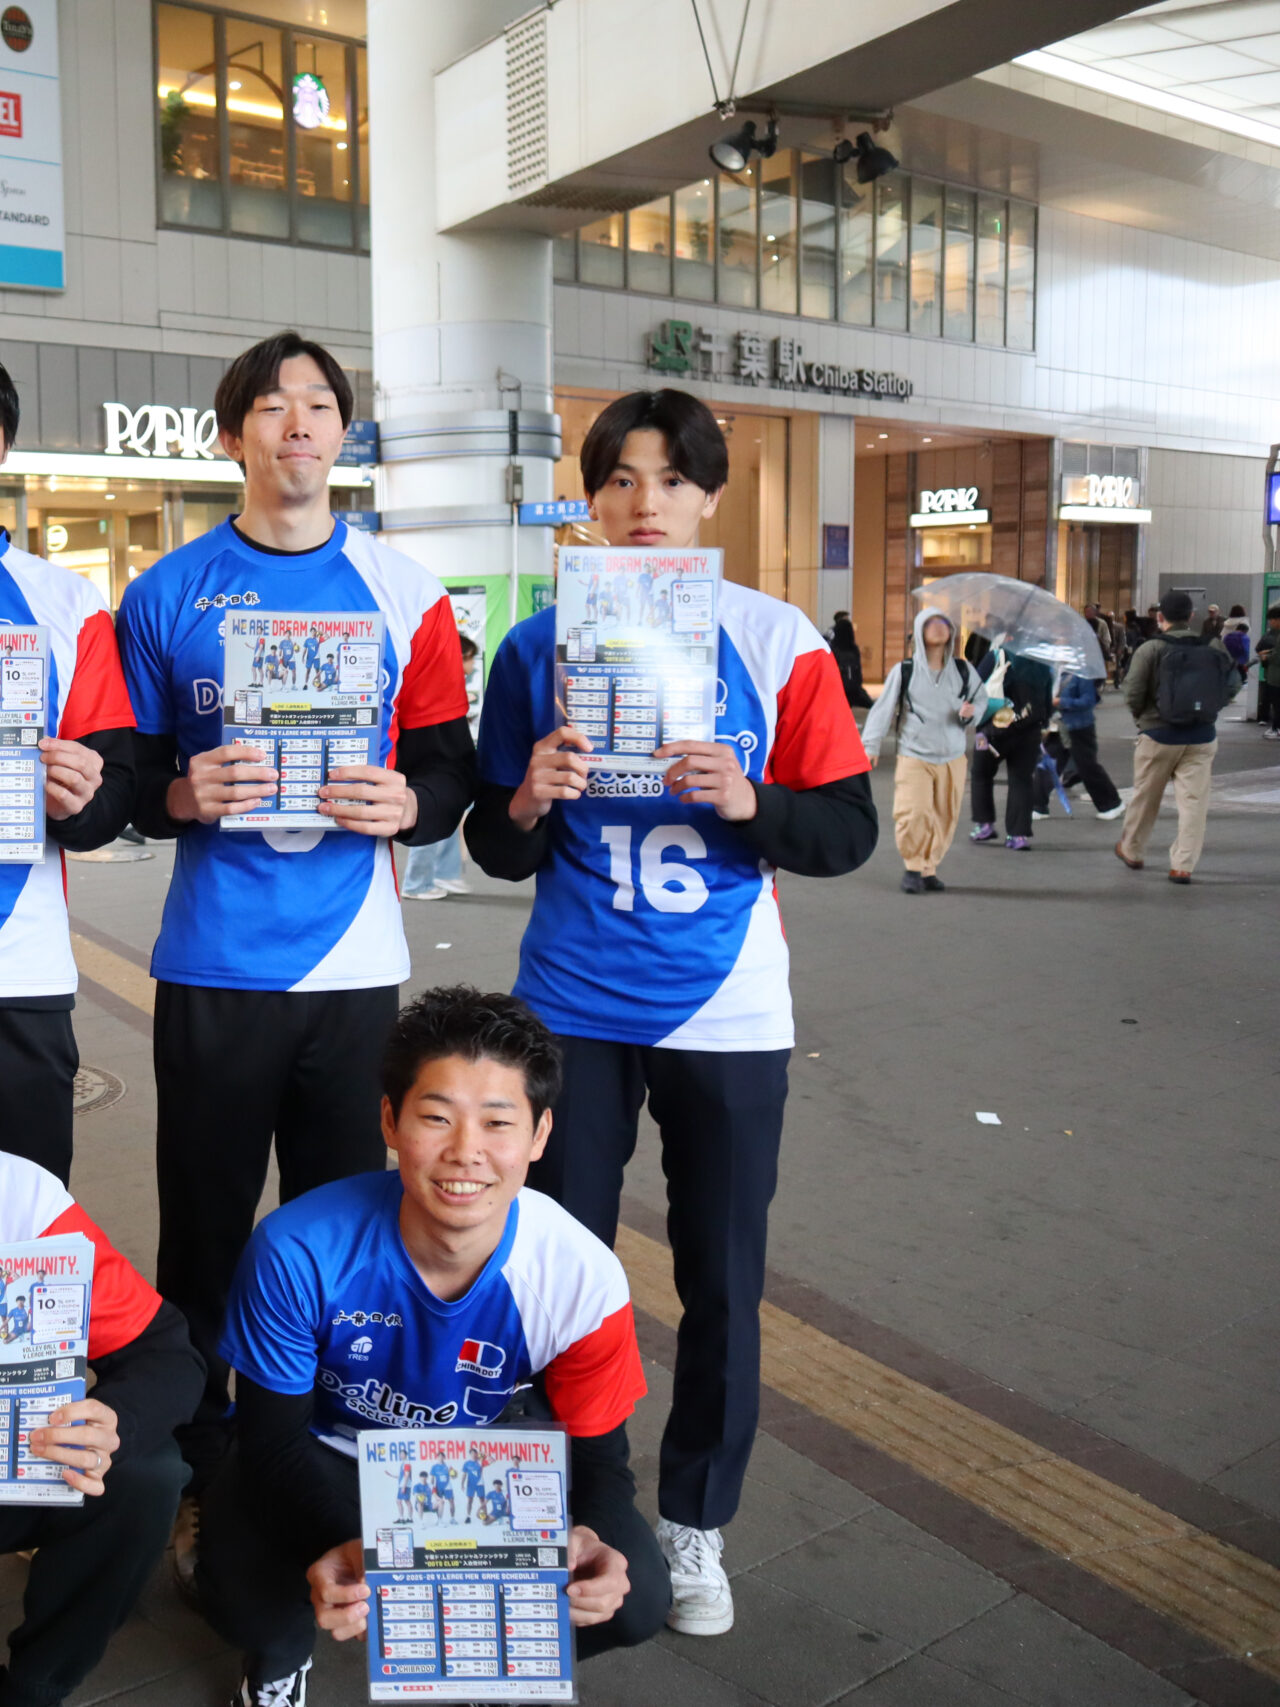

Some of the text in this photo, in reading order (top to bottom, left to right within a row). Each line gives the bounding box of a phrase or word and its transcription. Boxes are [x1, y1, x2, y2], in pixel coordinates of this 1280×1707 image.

[698, 327, 806, 384] 千葉駅
[811, 362, 858, 390] Chiba
[862, 370, 914, 397] Station
[195, 591, 260, 611] 千葉日報
[676, 594, 691, 604] 10
[232, 618, 247, 636] WE
[249, 619, 270, 636] ARE
[272, 620, 308, 637] DREAM
[343, 655, 357, 665] 10
[5, 670, 20, 681] 10
[588, 782, 661, 794] Social 3.0
[600, 824, 710, 914] 16
[38, 1298, 55, 1310] 10
[347, 1353, 369, 1362] TRES
[317, 1368, 458, 1425] Dotline
[345, 1397, 397, 1426] Social
[366, 1442, 386, 1463] WE
[389, 1441, 416, 1462] ARE
[419, 1440, 466, 1461] DREAM
[514, 1485, 532, 1497] 10
